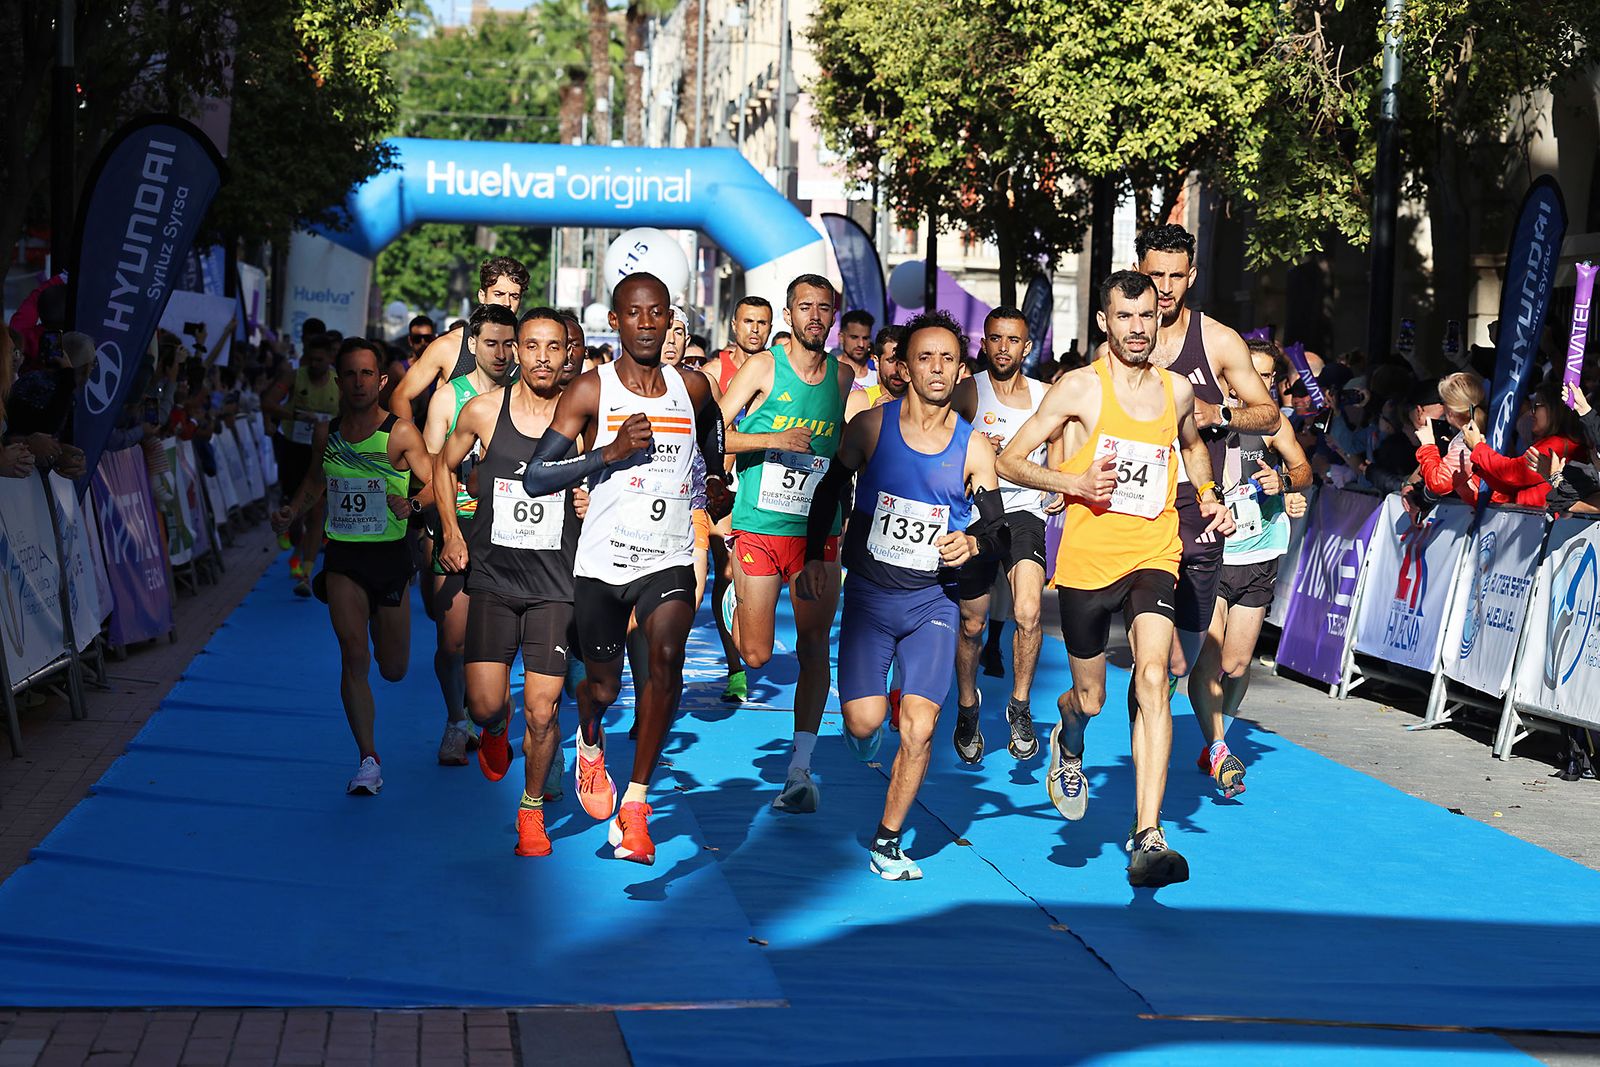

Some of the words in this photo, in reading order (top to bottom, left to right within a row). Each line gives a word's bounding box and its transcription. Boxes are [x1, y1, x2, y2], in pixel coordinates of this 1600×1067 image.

[426, 159, 555, 199] Huelva
[566, 166, 691, 210] original
[103, 139, 177, 332] HYUNDAI
[147, 243, 175, 300] Syrluz
[162, 185, 190, 242] Syrsa
[294, 286, 350, 306] Huelva
[1509, 200, 1553, 384] HYUNDAI
[1566, 298, 1590, 375] AVATEL
[1103, 438, 1120, 452] 2K
[770, 451, 784, 462] 2K
[1155, 448, 1166, 461] 2K
[813, 458, 826, 469] 2K
[782, 469, 811, 491] 57
[1116, 460, 1149, 487] 54
[367, 479, 381, 489] 2K
[498, 481, 513, 494] 2K
[629, 476, 646, 489] 2K
[340, 493, 366, 513] 49
[761, 496, 791, 508] Huelva
[762, 490, 791, 500] CUESTAS
[883, 495, 898, 510] 2K
[513, 500, 545, 524] 69
[649, 498, 667, 522] 9
[931, 507, 946, 519] 2K
[616, 525, 651, 542] Huelva
[879, 513, 942, 546] 1337
[610, 539, 626, 548] TOP
[869, 543, 901, 560] Huelva
